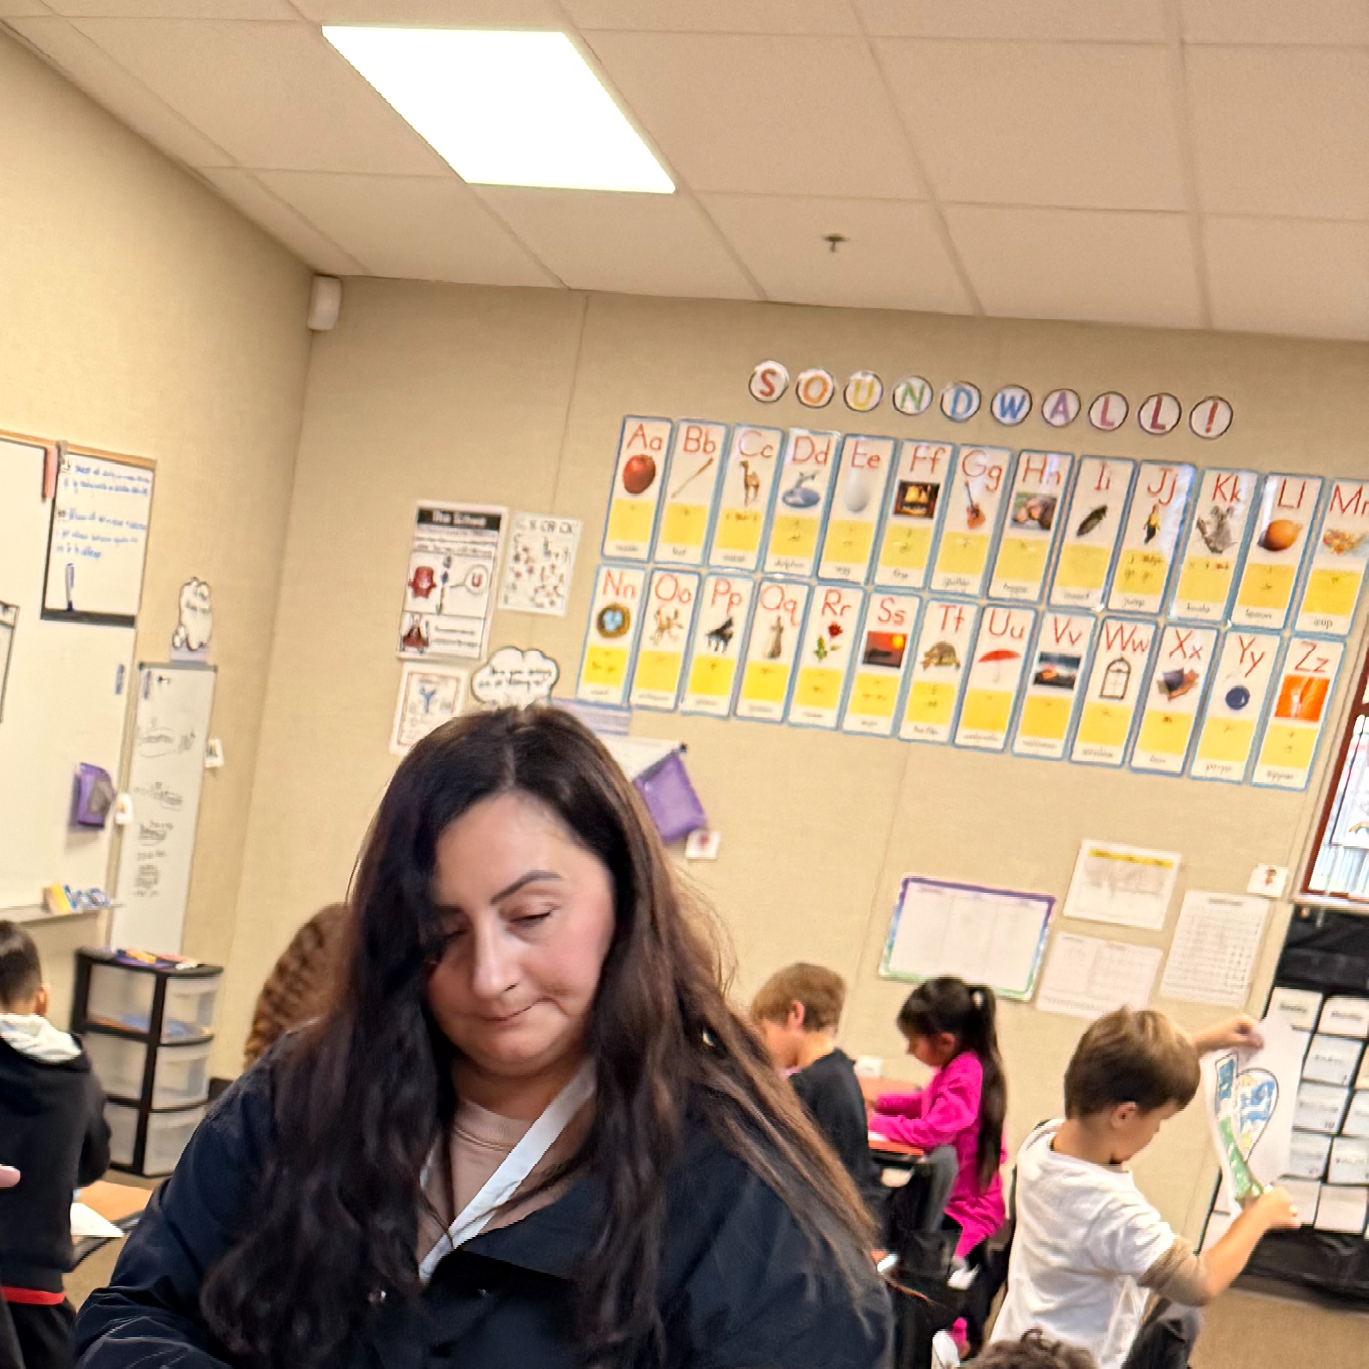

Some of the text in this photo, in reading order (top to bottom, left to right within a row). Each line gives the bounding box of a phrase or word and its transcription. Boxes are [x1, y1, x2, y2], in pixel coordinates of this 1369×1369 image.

[626, 423, 663, 452] Aa
[683, 425, 717, 454] Bb
[739, 430, 773, 459] Cc
[791, 435, 828, 466] Dd
[850, 442, 880, 470] Ee
[910, 444, 945, 474] Ff
[962, 449, 1002, 492] Gg
[1022, 455, 1061, 485] Hh
[1094, 463, 1112, 491] Ii
[1147, 467, 1177, 505] Jj
[1212, 473, 1241, 502] Kk
[1277, 479, 1306, 510] Ll
[601, 569, 637, 599] Nn
[654, 574, 692, 603] Oo
[711, 578, 742, 616] Pp
[820, 588, 852, 617] Rr
[877, 596, 906, 626] Ss
[938, 603, 965, 634] Tt
[989, 609, 1025, 640] Uu
[1053, 616, 1083, 647] Vv
[1104, 622, 1149, 655] Ww
[1169, 629, 1203, 660] Xx
[1238, 635, 1265, 678] Yy
[1294, 640, 1330, 673] Zz
